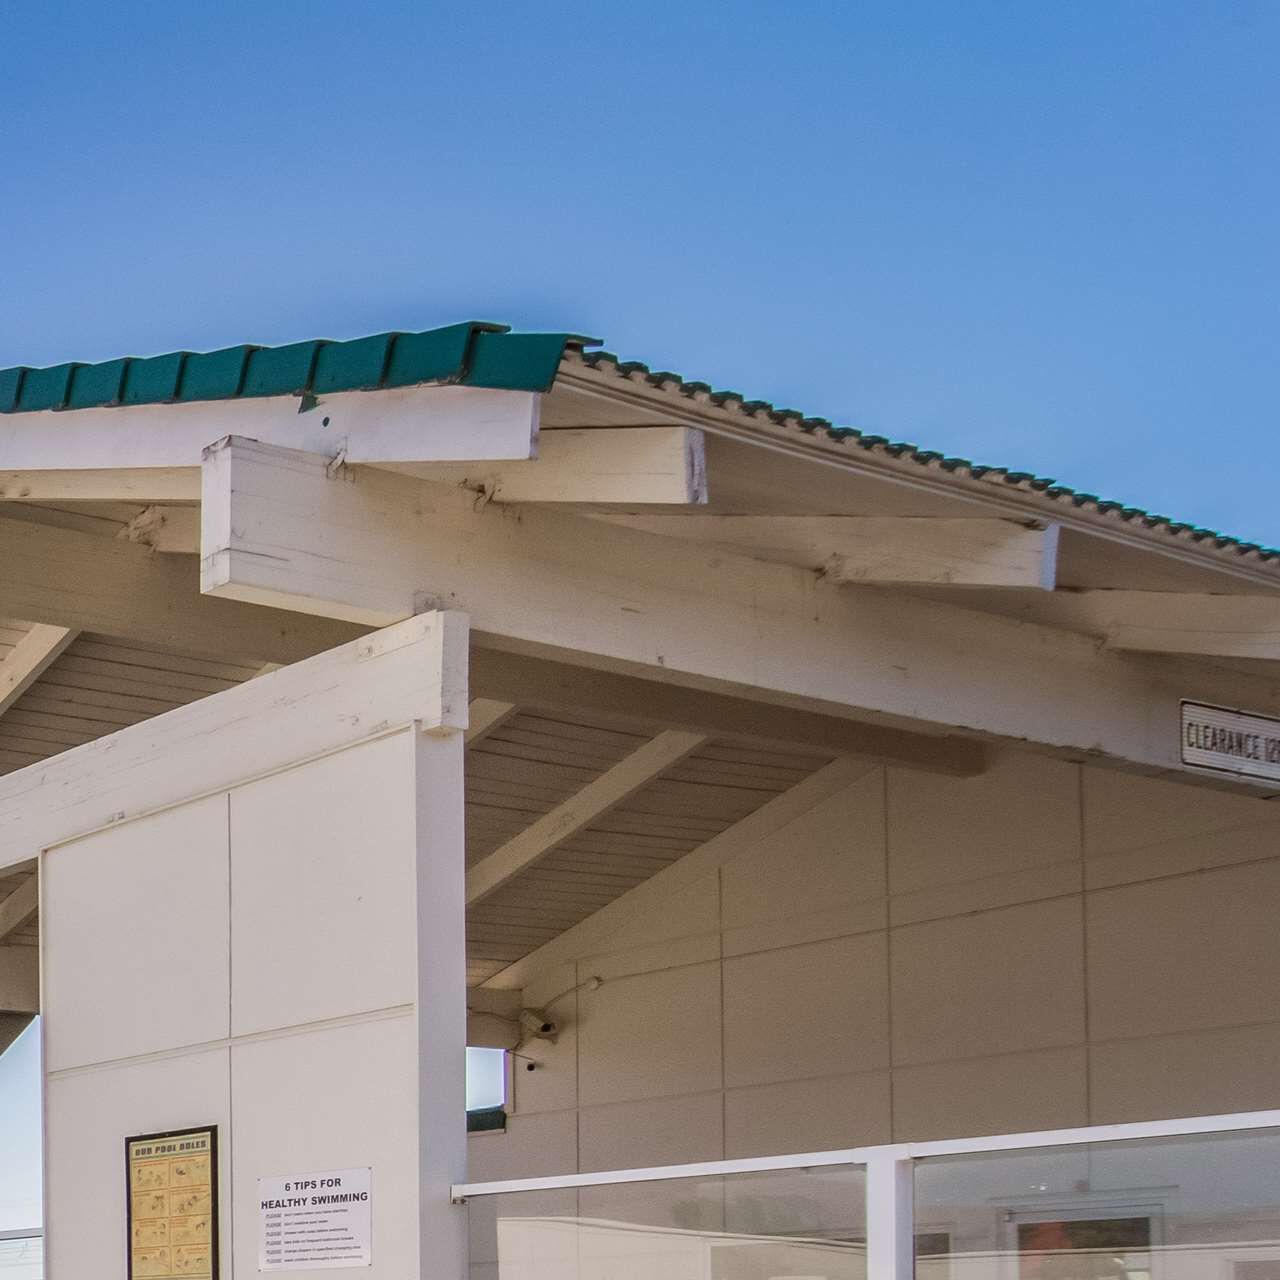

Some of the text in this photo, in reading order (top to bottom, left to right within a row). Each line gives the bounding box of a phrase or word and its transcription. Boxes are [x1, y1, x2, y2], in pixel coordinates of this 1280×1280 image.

[1186, 722, 1260, 760] CLEARANCE
[284, 1178, 342, 1191] 6 TIPS FOR
[261, 1192, 368, 1210] HEALTHY SWIMMING
